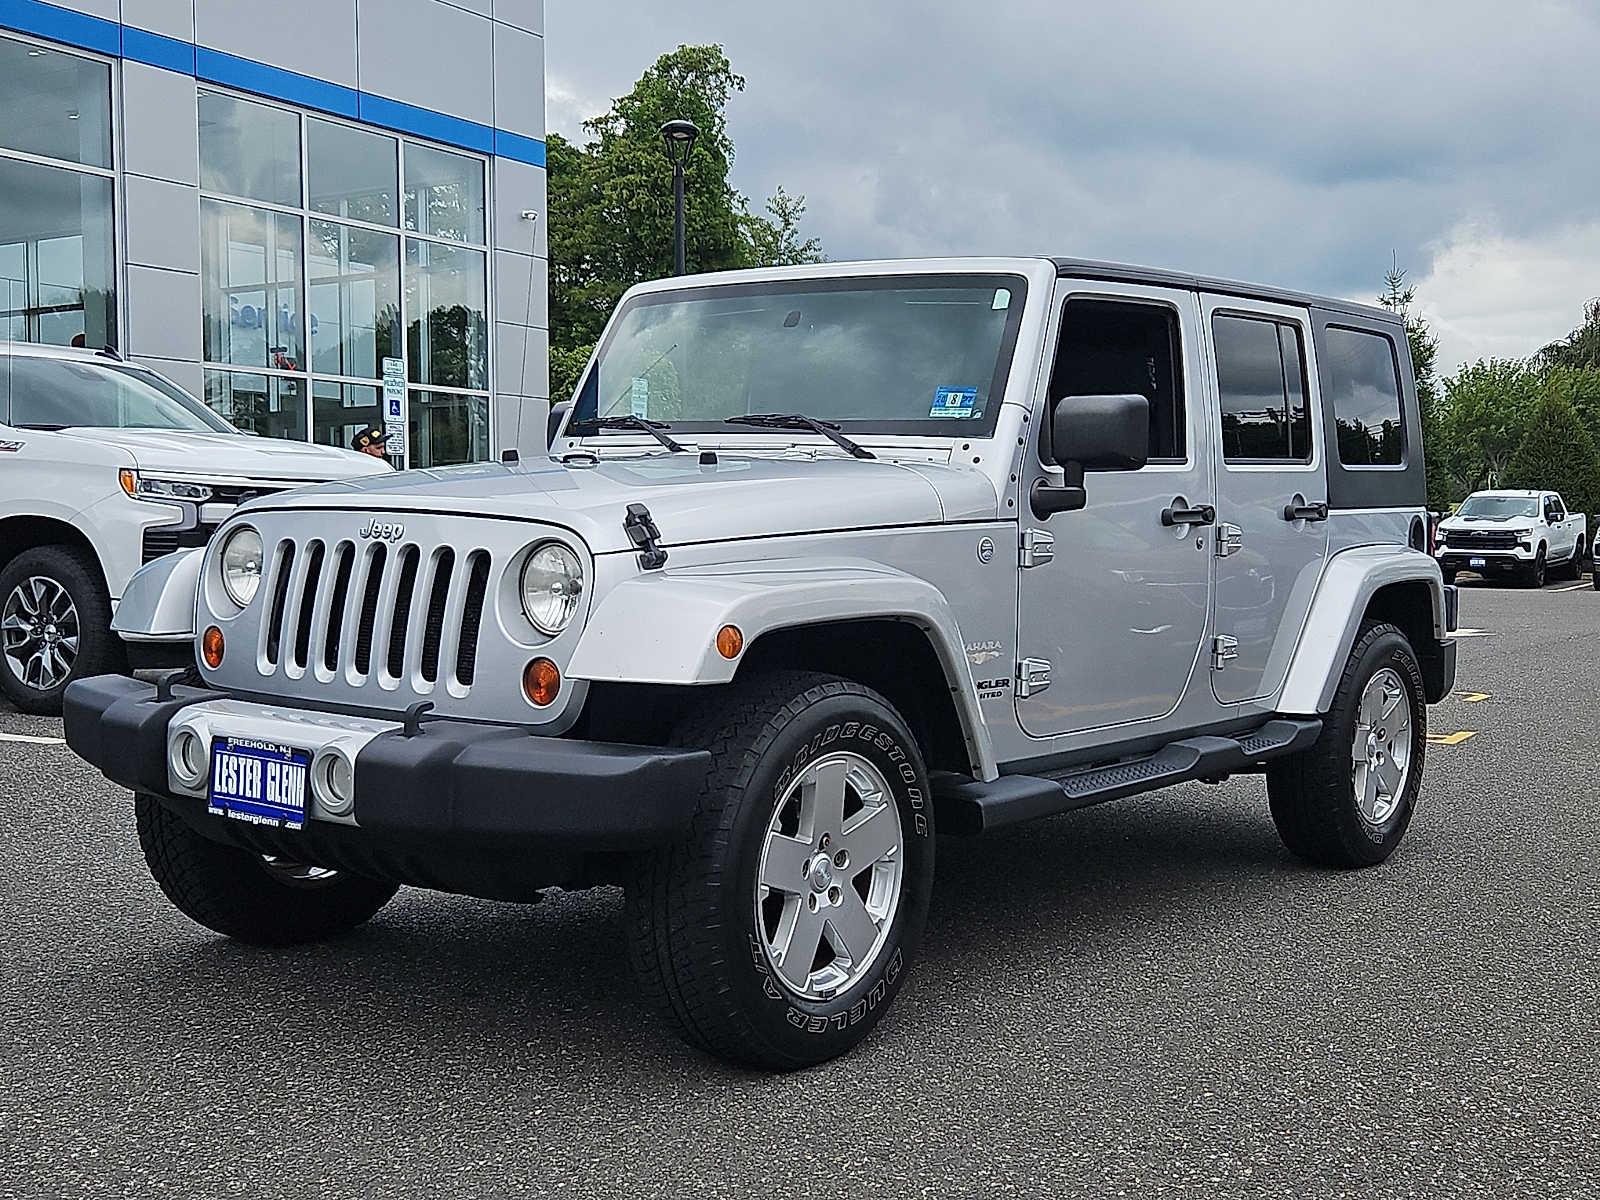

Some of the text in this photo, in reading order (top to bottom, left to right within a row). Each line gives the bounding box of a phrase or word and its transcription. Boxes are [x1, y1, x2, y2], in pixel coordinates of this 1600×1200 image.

[360, 517, 405, 544] Jeep
[966, 641, 1002, 652] AHARA
[214, 754, 306, 808] LESTER GLENN
[774, 721, 929, 838] BRIDGESTONE
[785, 947, 903, 1034] DUELER
